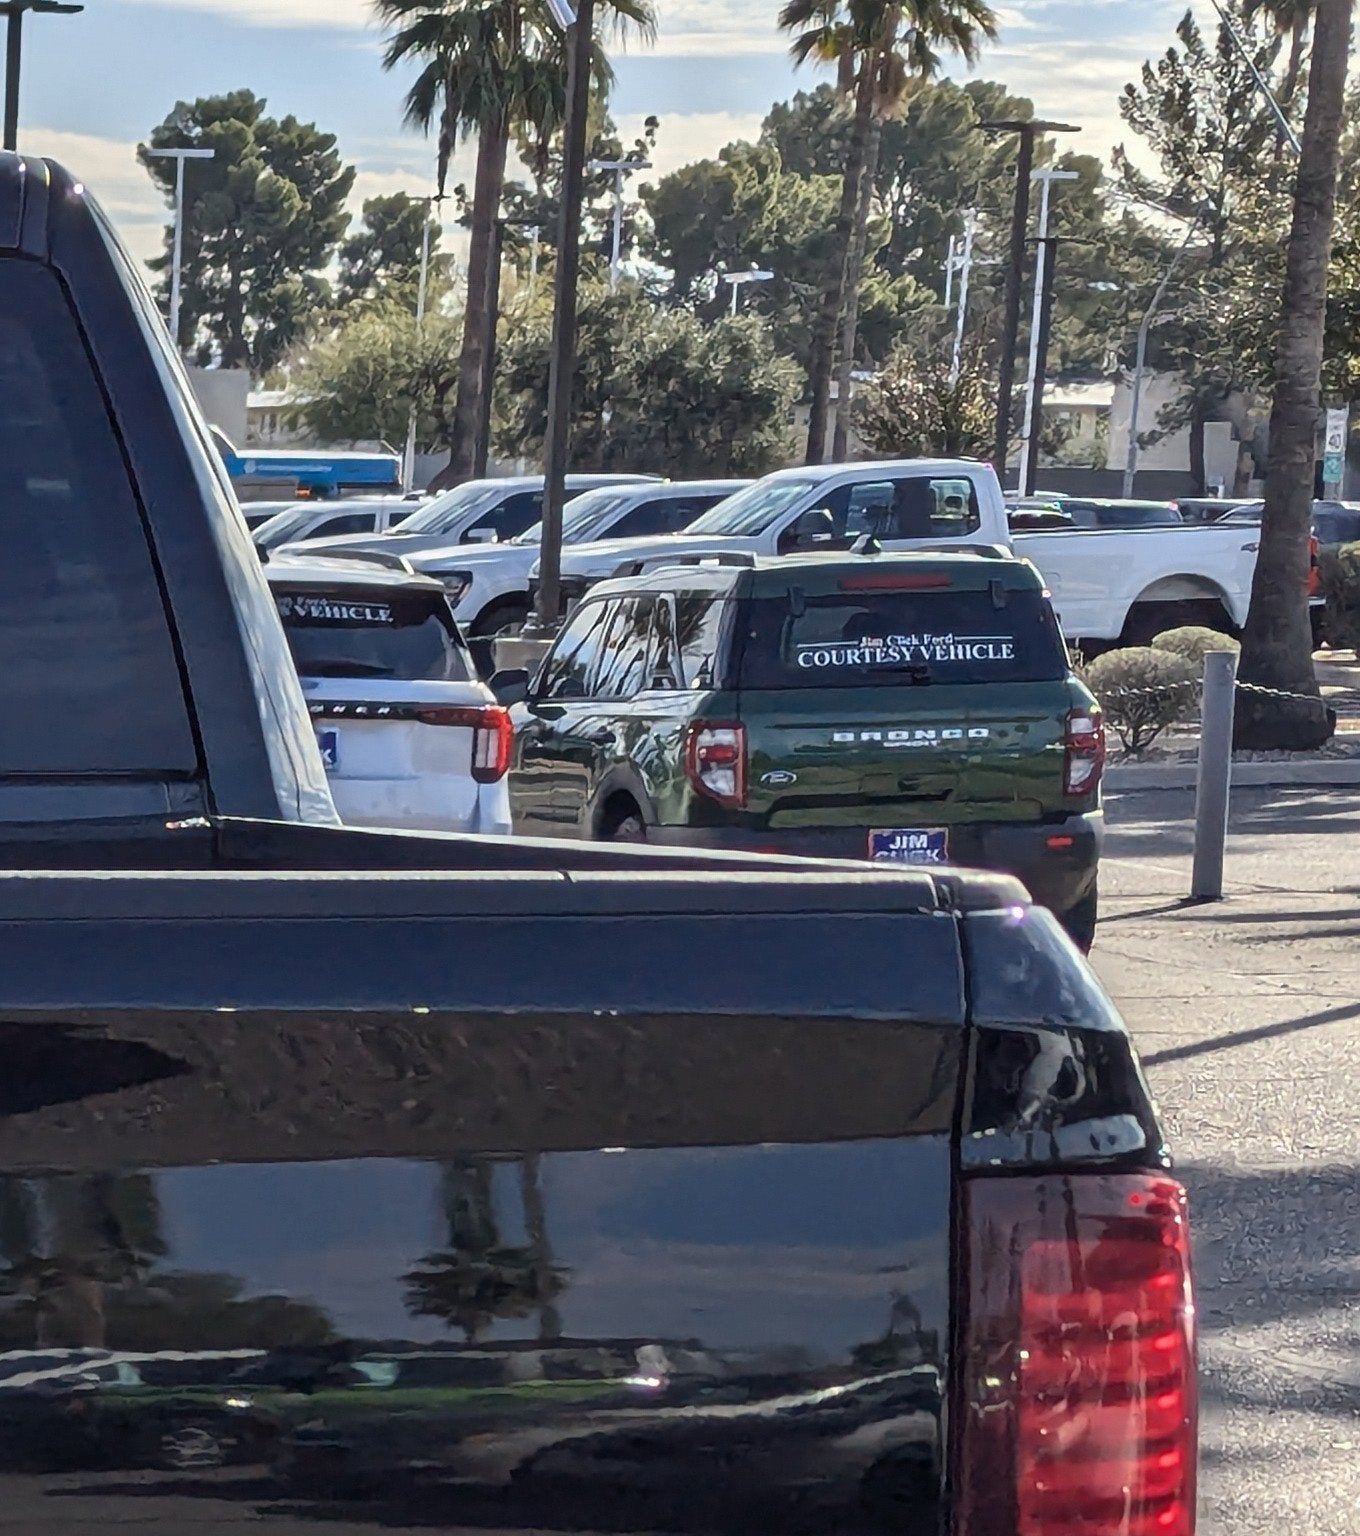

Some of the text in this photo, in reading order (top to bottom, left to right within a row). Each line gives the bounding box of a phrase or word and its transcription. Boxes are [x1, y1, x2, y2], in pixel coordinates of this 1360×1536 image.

[797, 643, 1016, 668] COURTESY VEHICLE
[833, 728, 990, 742] BRONCO
[888, 834, 928, 850] JIM
